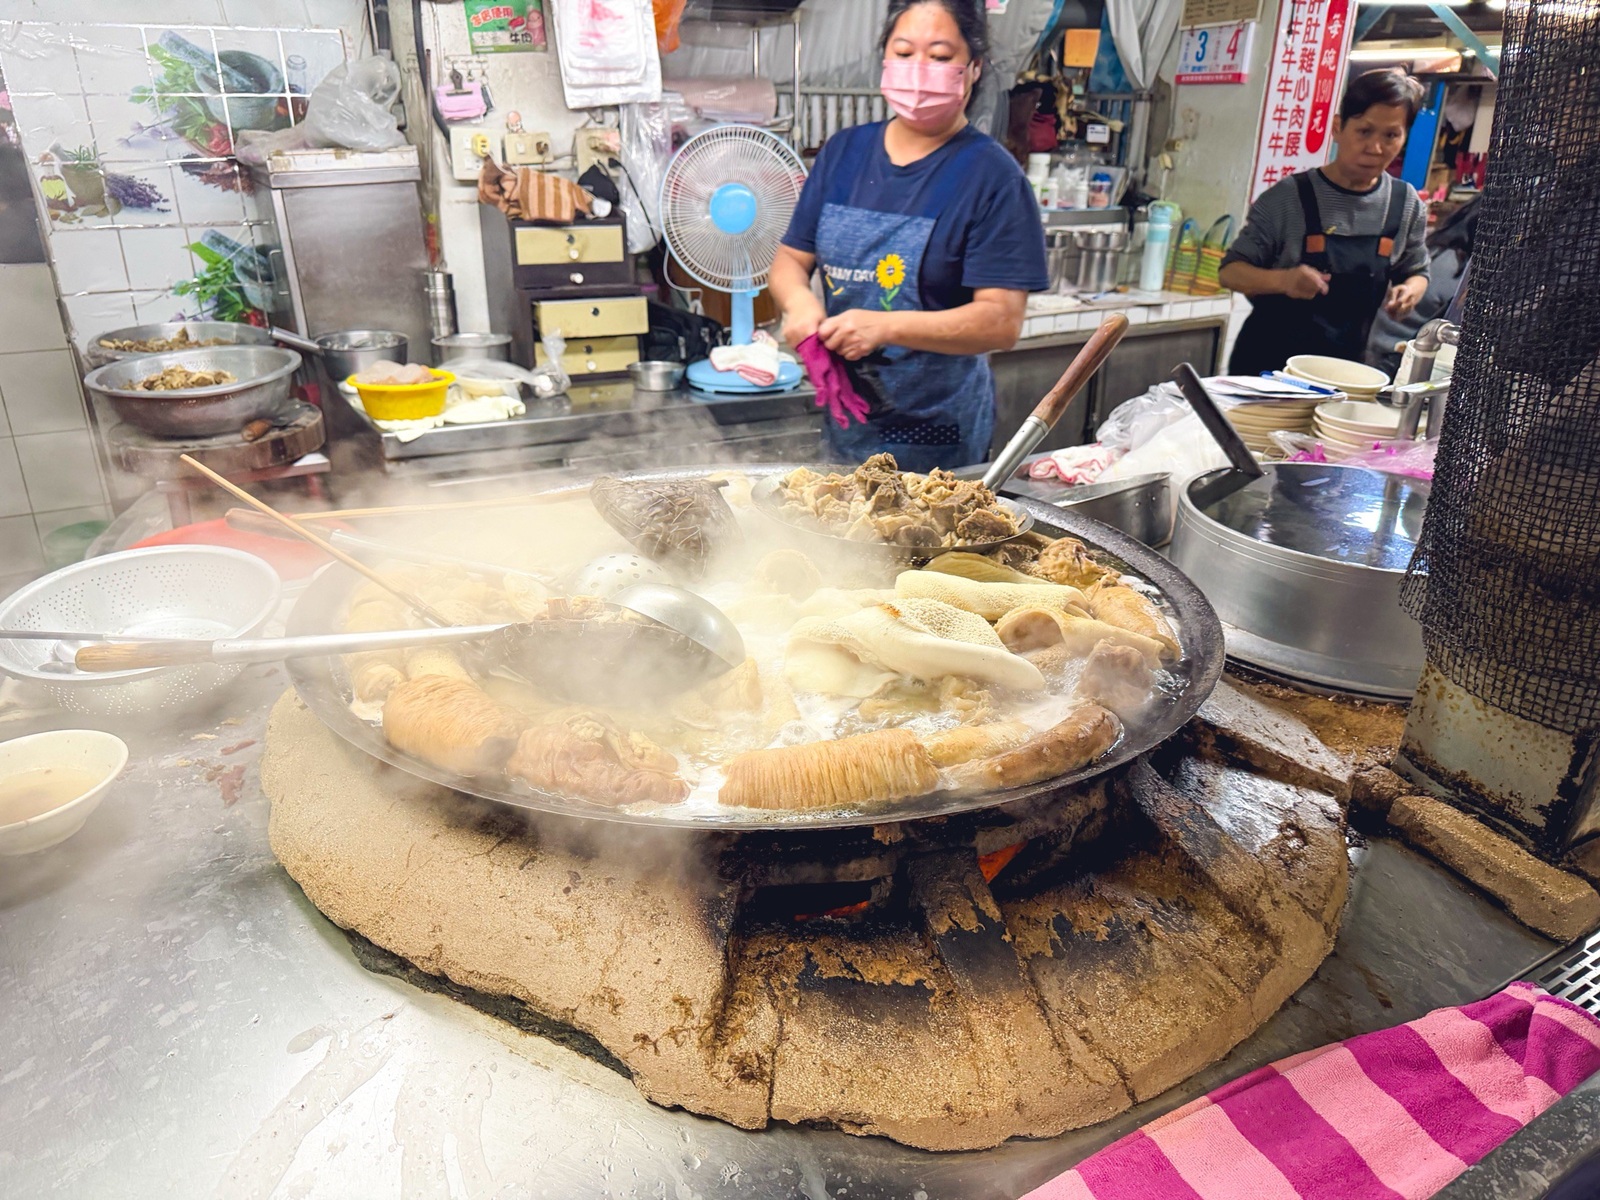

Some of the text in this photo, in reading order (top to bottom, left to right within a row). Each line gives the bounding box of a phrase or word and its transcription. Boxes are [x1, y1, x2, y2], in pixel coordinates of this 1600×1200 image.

[1195, 31, 1208, 62] 3
[1226, 28, 1243, 61] 4
[1276, 75, 1310, 101] 牛心
[1272, 103, 1305, 129] 牛肉
[853, 269, 876, 282] DAY
